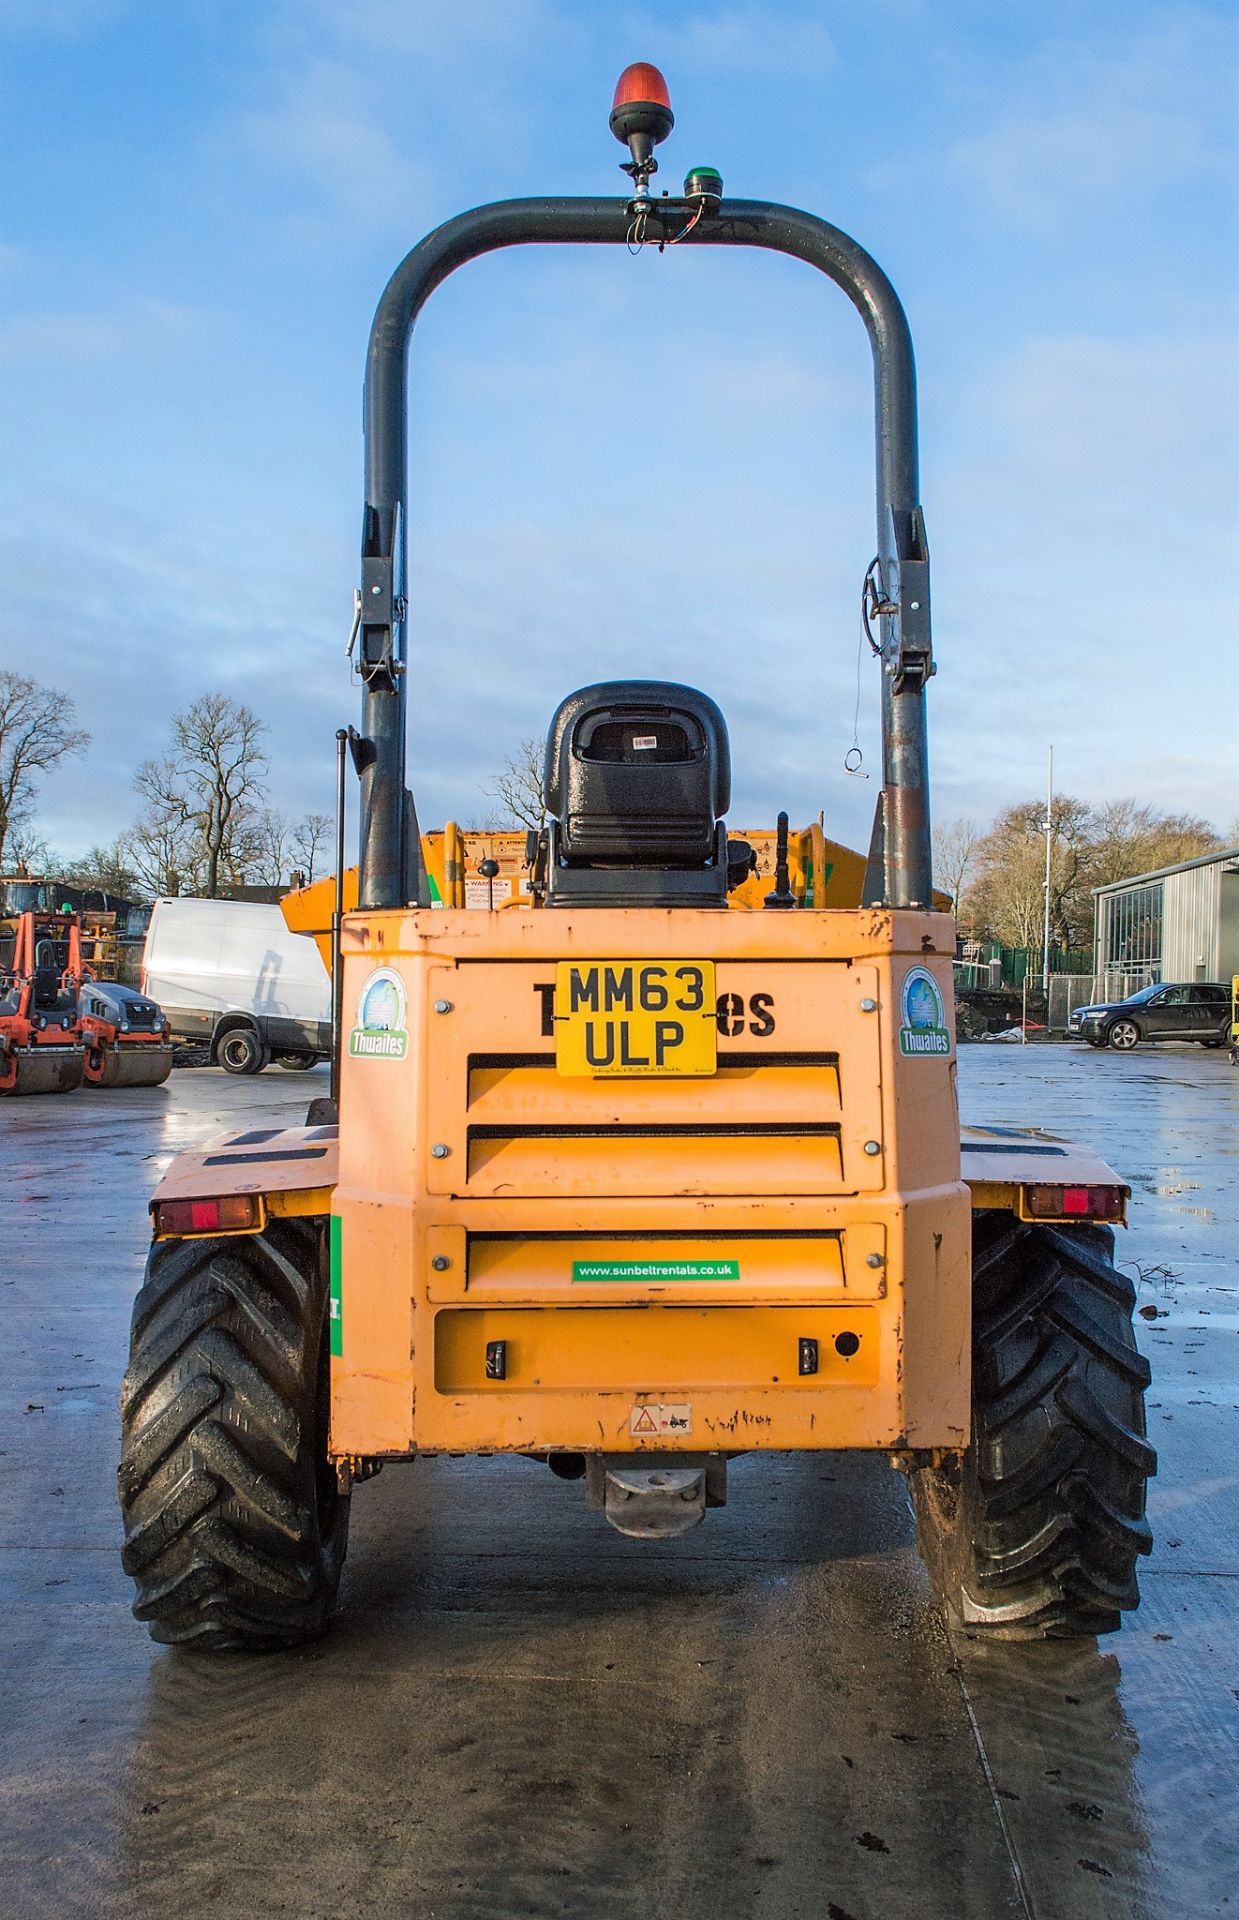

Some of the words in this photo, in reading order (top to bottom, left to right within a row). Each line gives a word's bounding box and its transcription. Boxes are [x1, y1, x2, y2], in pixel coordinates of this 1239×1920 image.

[570, 967, 704, 1013] MM63
[353, 1031, 404, 1055] Thwaites
[585, 1021, 684, 1067] ULP
[903, 1031, 948, 1052] Thwaites
[579, 1264, 733, 1276] www.sunbeltrentals.co.uk
